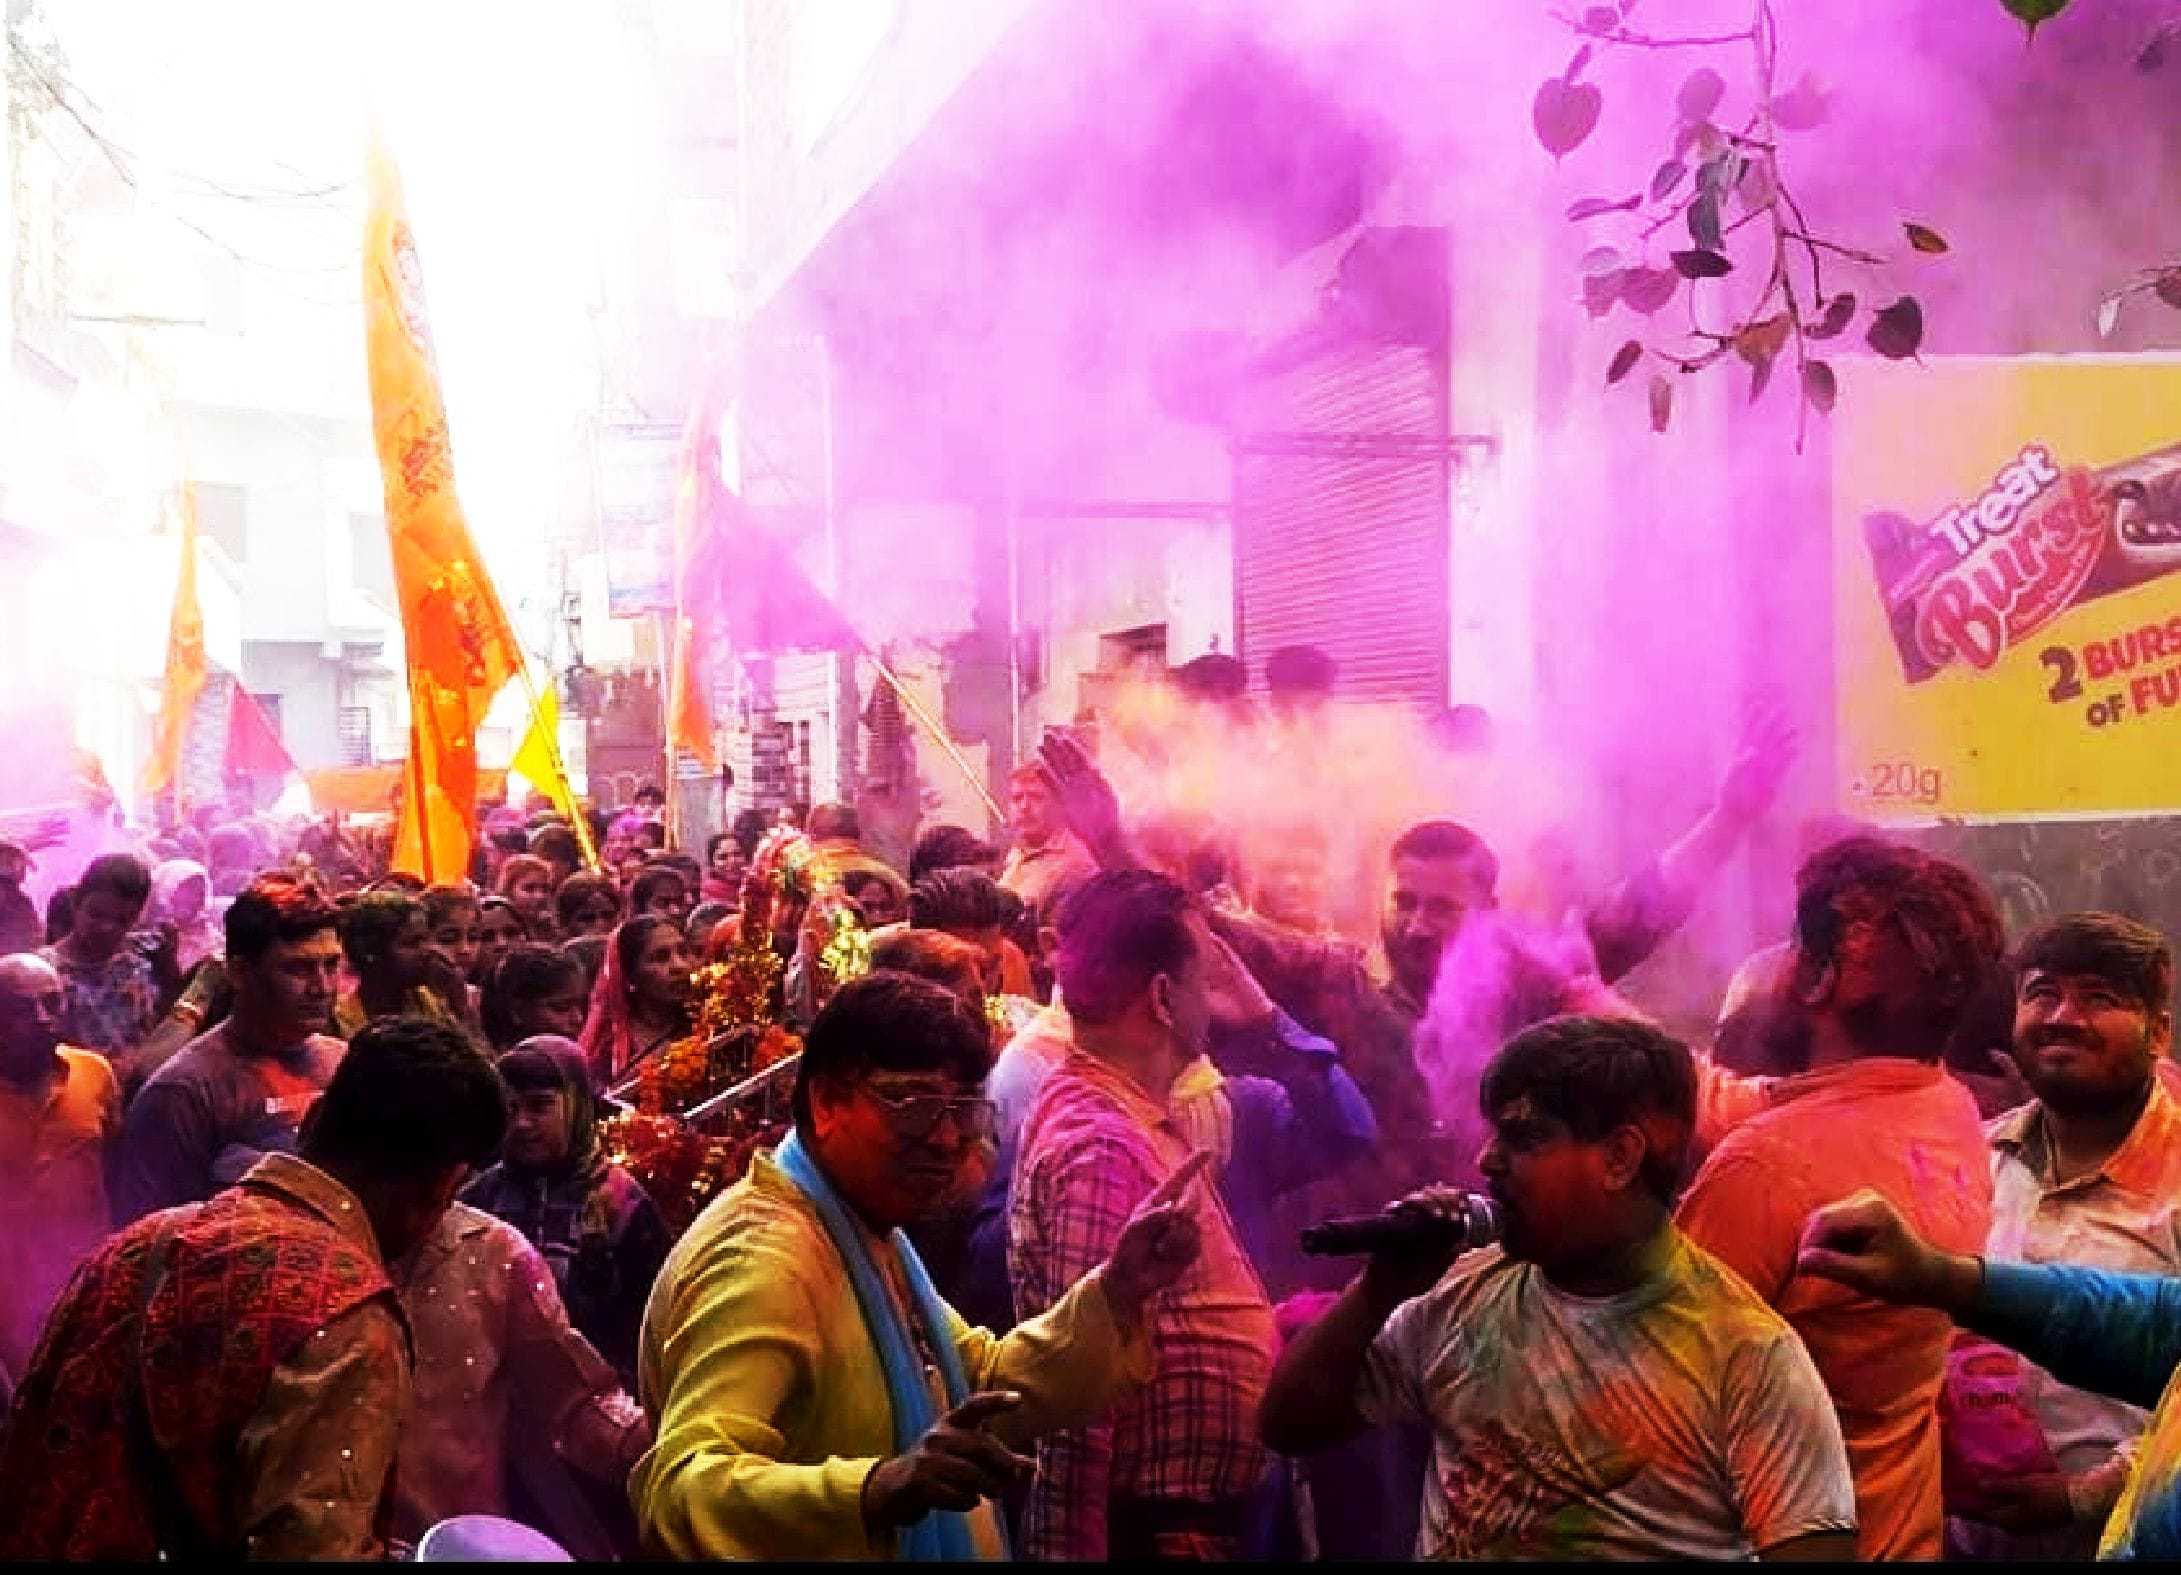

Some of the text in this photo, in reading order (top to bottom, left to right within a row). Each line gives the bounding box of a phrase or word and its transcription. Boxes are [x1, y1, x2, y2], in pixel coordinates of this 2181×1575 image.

[1928, 446, 2058, 555] Treat
[1923, 466, 2104, 668] Burst
[2039, 646, 2083, 704] 2
[2087, 664, 2181, 727] OF FU
[1871, 763, 1941, 805] 20g
